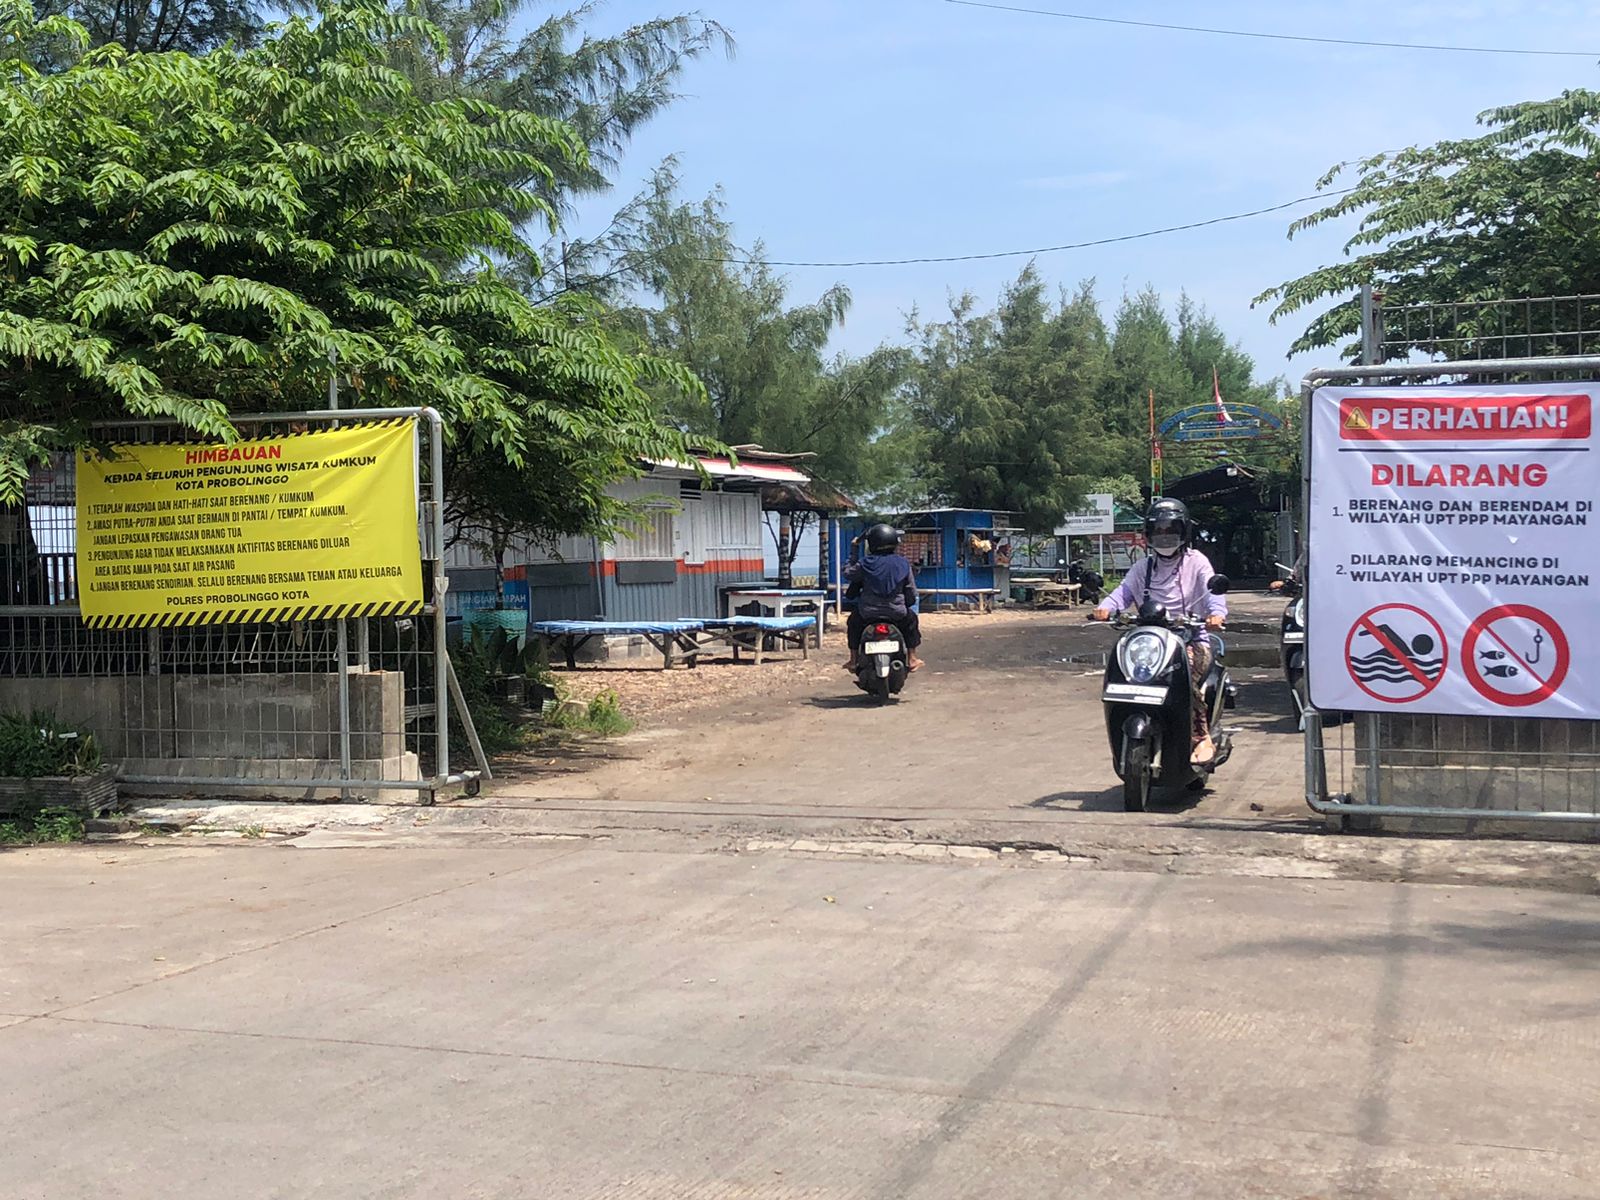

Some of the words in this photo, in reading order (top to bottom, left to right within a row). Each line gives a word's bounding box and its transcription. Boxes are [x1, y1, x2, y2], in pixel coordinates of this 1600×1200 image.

[1371, 405, 1568, 430] PERHATIAN!
[185, 445, 282, 464] HIMBAUAN
[104, 472, 142, 483] KEPADA
[145, 469, 194, 480] SELURUH
[196, 464, 272, 477] PENGUNJUNG
[276, 461, 320, 472] WISATA
[322, 456, 376, 468] KUMKUM
[1371, 464, 1548, 487] DILARANG
[176, 481, 204, 490] KOTA
[207, 475, 289, 488] PROBOLINGGO
[124, 502, 156, 513] WASPADA
[157, 500, 171, 512] DAN
[172, 498, 208, 510] HATI-HATI
[210, 496, 228, 508] SAAT
[230, 494, 270, 506] BERENANG
[278, 491, 314, 503] KUMKUM
[1348, 499, 1434, 511] BERENANG
[1439, 500, 1472, 512] DAN
[1480, 500, 1569, 512] BERENDAM
[1576, 500, 1592, 512] DI
[113, 517, 157, 528] PUTRA-PUTRI
[158, 516, 176, 526] ANDA
[177, 514, 195, 526] SAAT
[197, 512, 230, 524] BERMAIN
[232, 512, 240, 522] DI
[242, 510, 268, 522] PANTAI
[278, 508, 308, 520] TEMPAT
[310, 505, 348, 518] KUMKUM.
[1332, 506, 1344, 516] 1.
[1348, 512, 1420, 524] WILAYAH
[1424, 514, 1456, 524] UPT
[1458, 514, 1489, 525] PPP
[1492, 514, 1587, 526] MAYANGAN
[93, 534, 116, 546] JANGAN
[118, 533, 150, 544] LEPASKAN
[151, 530, 199, 542] PENGAWASAN
[200, 528, 226, 540] ORANG
[227, 528, 242, 538] TUA
[135, 548, 152, 558] AGAR
[154, 547, 174, 558] TIDAK
[176, 544, 235, 557] MELAKSANAKAN
[236, 542, 276, 554] AKTIFITAS
[277, 538, 318, 551] BERENANG
[320, 536, 350, 548] DILUAR
[95, 566, 111, 576] AREA
[112, 564, 132, 576] BATAS
[132, 563, 152, 574] AMAN
[154, 562, 172, 573] PADA
[172, 562, 191, 572] SAAT
[192, 560, 204, 572] AIR
[206, 560, 236, 570] PASANG
[1336, 564, 1347, 575] 2.
[1350, 554, 1432, 566] DILARANG
[1436, 555, 1538, 568] MEMANCING
[1542, 558, 1558, 568] DI
[120, 580, 155, 590] BERENANG
[198, 576, 225, 587] SELALU
[226, 574, 266, 586] BERENANG
[268, 572, 306, 584] BERSAMA
[307, 570, 336, 582] TEMAN
[338, 568, 358, 580] ATAU
[360, 566, 402, 578] KELUARGA
[1350, 571, 1422, 582] WILAYAH
[1426, 572, 1458, 584] UPT
[1461, 573, 1492, 584] PPP
[1495, 574, 1589, 586] MAYANGAN
[166, 596, 204, 606] POLRES
[206, 592, 279, 604] PROBOLINGGO
[282, 590, 310, 600] KOTA
